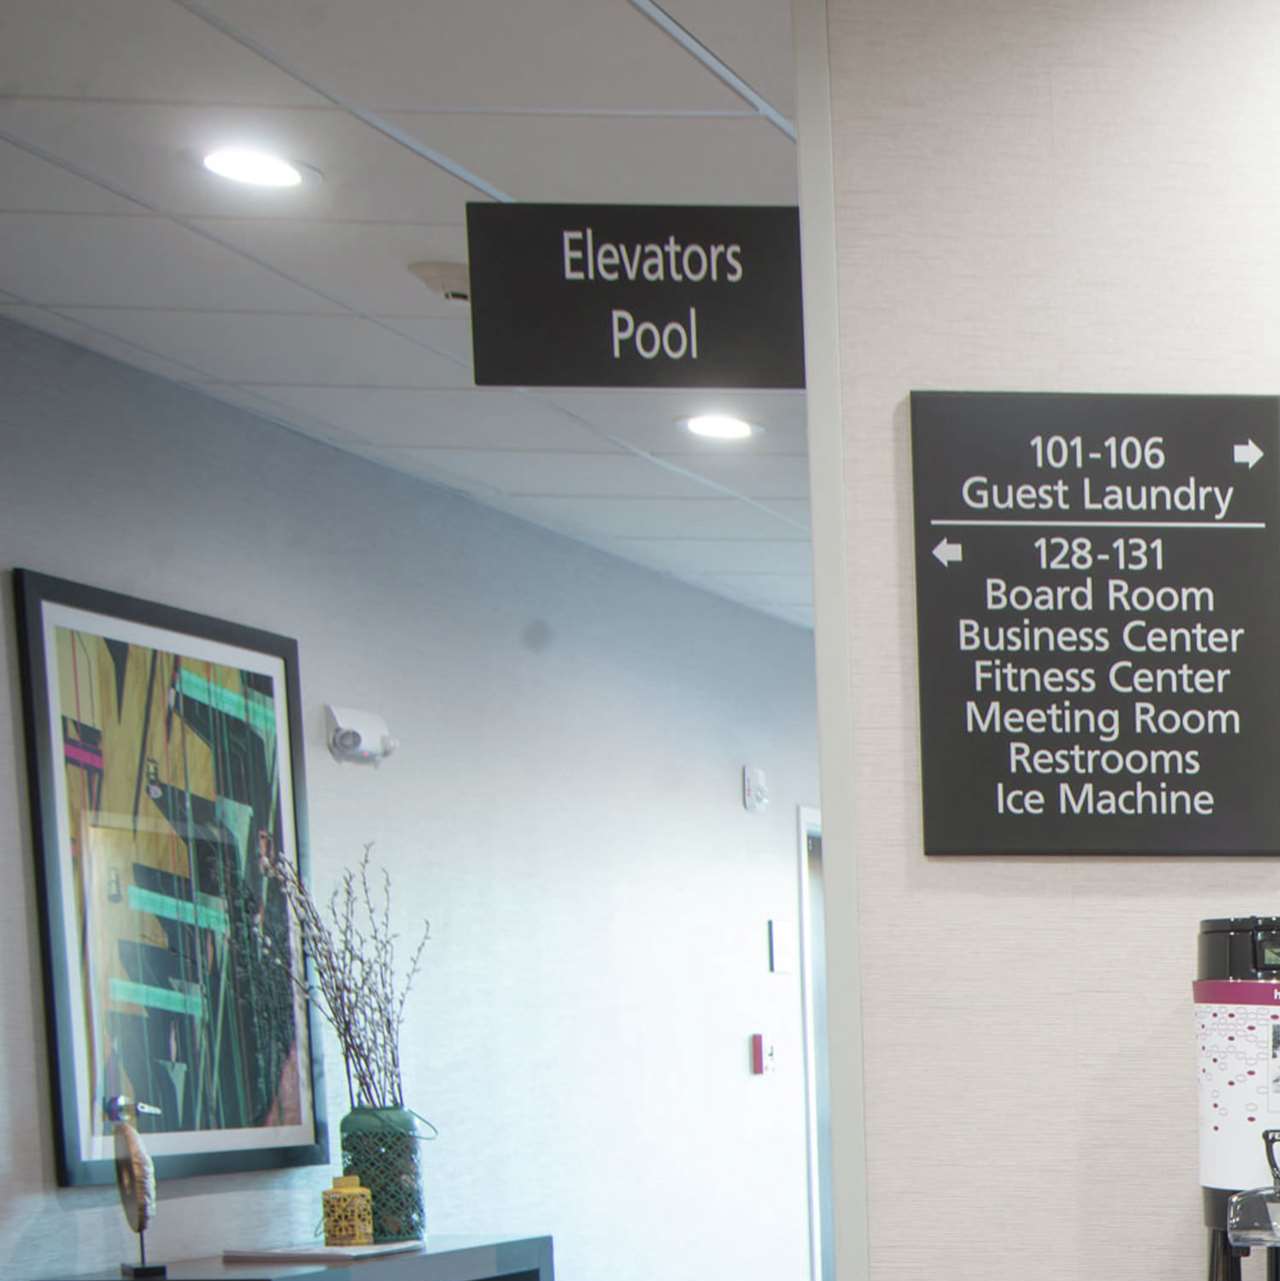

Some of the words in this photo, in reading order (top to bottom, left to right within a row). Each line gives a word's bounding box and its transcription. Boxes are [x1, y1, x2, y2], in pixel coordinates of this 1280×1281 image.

[564, 229, 742, 281] Elevators
[612, 308, 698, 359] Pool
[1030, 435, 1166, 470] 101-106
[962, 476, 1070, 510] Guest
[1083, 476, 1234, 520] Laundry
[1034, 537, 1163, 571] 128-131
[986, 576, 1093, 611] Board
[1108, 579, 1214, 612] Room
[959, 618, 1110, 652] Business
[1122, 619, 1245, 653] Center
[975, 659, 1096, 693] Fitness
[1109, 660, 1231, 694] Center
[966, 700, 1120, 742] Meeting
[1135, 702, 1240, 734] Room
[1010, 742, 1201, 775] Restrooms
[997, 782, 1045, 814] Ice
[1059, 781, 1215, 815] Machine
